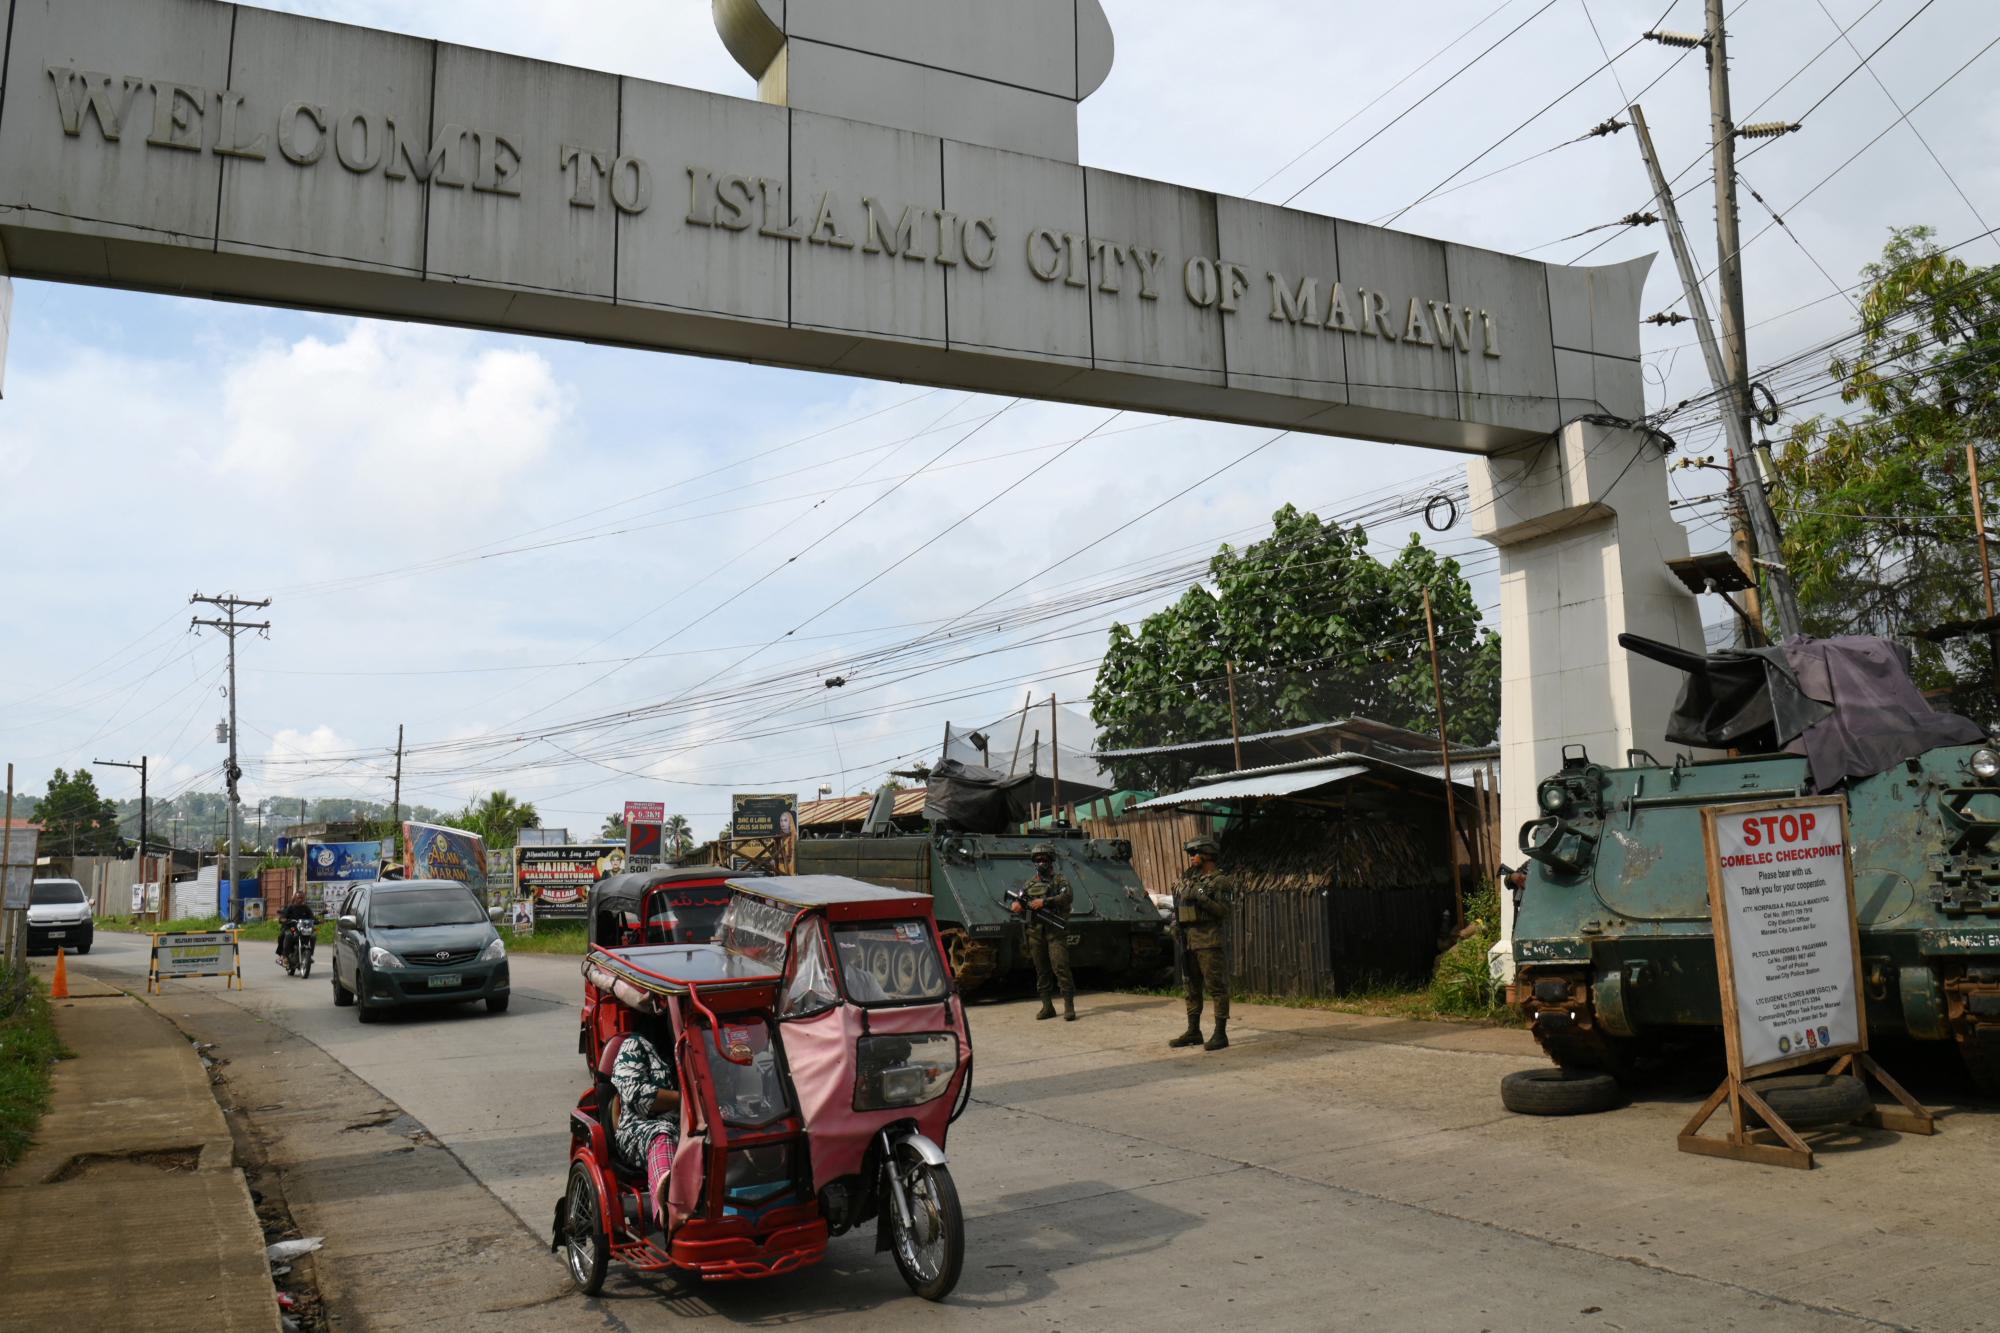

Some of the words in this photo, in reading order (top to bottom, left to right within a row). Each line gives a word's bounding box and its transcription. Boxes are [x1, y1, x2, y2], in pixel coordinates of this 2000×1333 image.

[47, 65, 522, 197] WELCOME
[560, 142, 653, 216] TO
[686, 165, 997, 271] ISLAMIC
[1026, 226, 1164, 300] CITY
[1183, 255, 1250, 313] OF
[1266, 271, 1502, 358] MARAWI
[1742, 812, 1817, 846] STOP
[628, 856, 661, 864] PETRON
[1721, 851, 1773, 868] COMELEC
[1776, 844, 1842, 861] CHECKPOINT
[429, 865, 470, 880] MARAWI
[1758, 870, 1777, 880] Please
[1778, 868, 1791, 878] bear
[1792, 868, 1804, 876] with
[1741, 885, 1760, 895] Thank
[1762, 887, 1773, 895] you
[1774, 883, 1782, 892] for
[1783, 884, 1796, 892] your
[1761, 928, 1777, 936] Marawi
[1065, 934, 1081, 945] 23
[1759, 1011, 1785, 1022] Commanding
[1786, 1008, 1800, 1016] Officer
[1825, 1000, 1840, 1008] Marawi
[1773, 1019, 1787, 1027] Marawi
